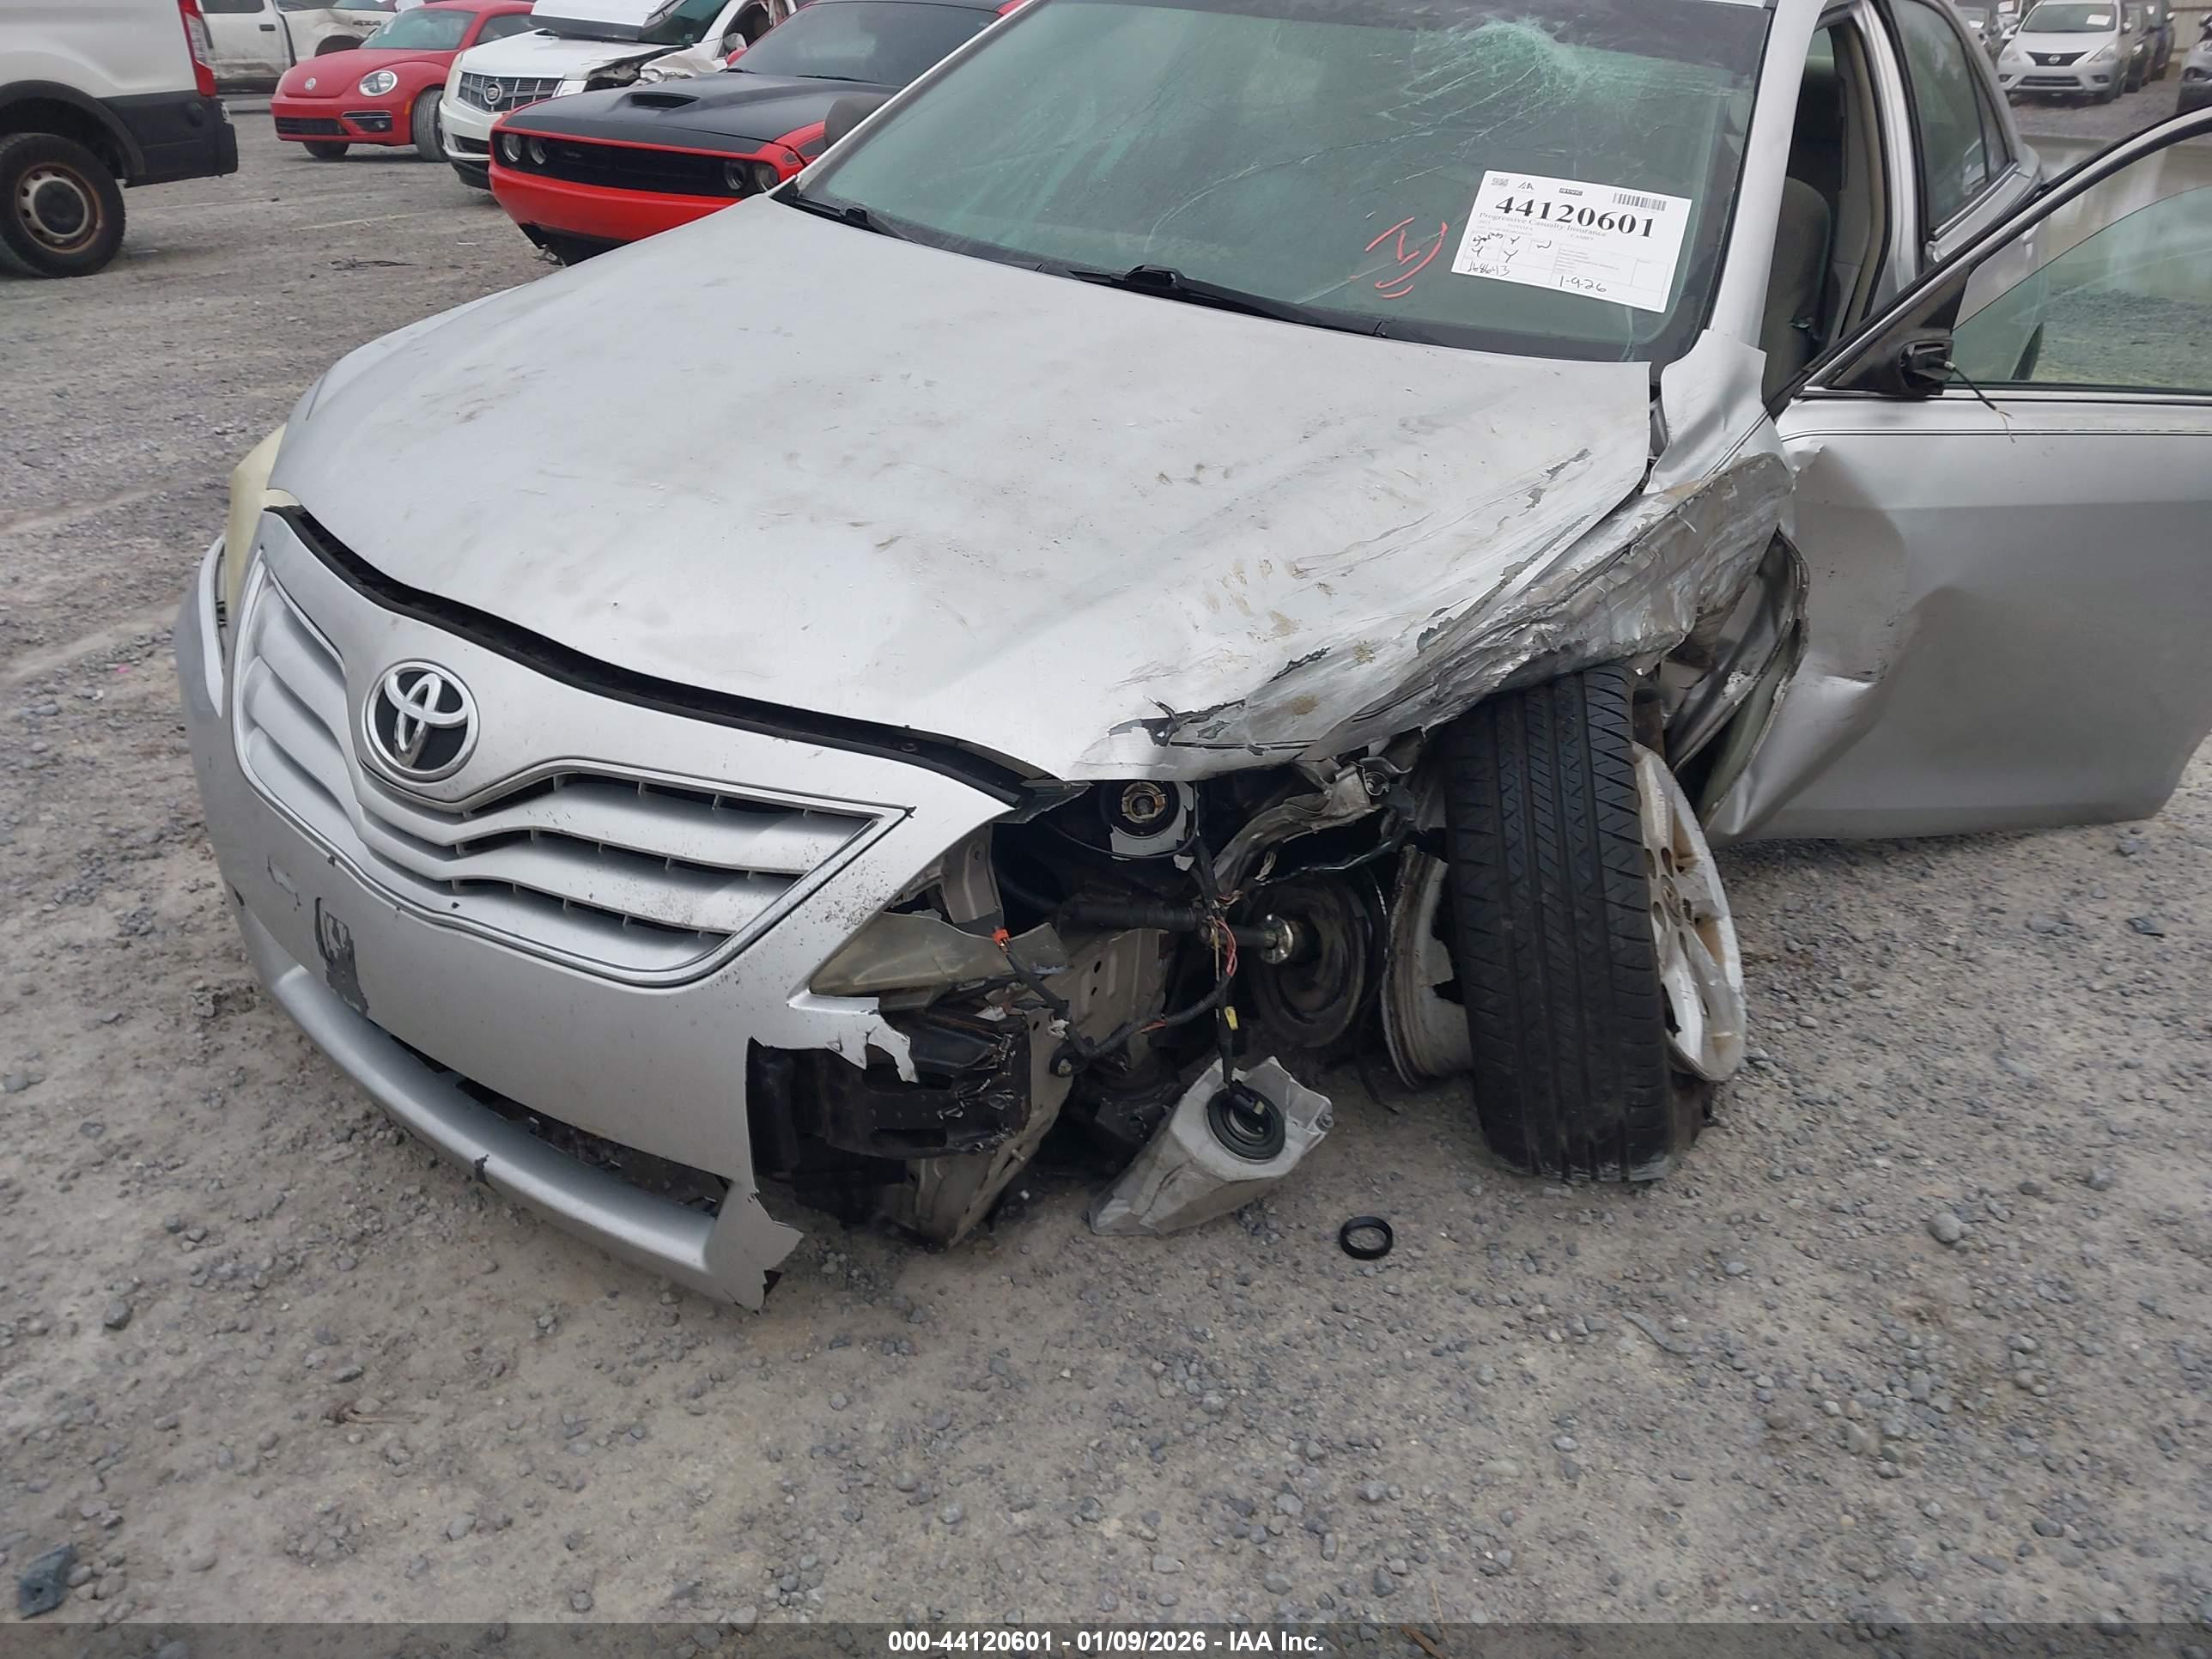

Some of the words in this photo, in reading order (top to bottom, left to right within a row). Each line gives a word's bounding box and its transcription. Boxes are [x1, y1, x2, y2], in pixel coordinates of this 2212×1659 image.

[1479, 212, 1528, 223] Progressive
[1528, 219, 1564, 231] Casualty
[1566, 225, 1607, 237] Insurance
[1495, 196, 1655, 240] 44120601
